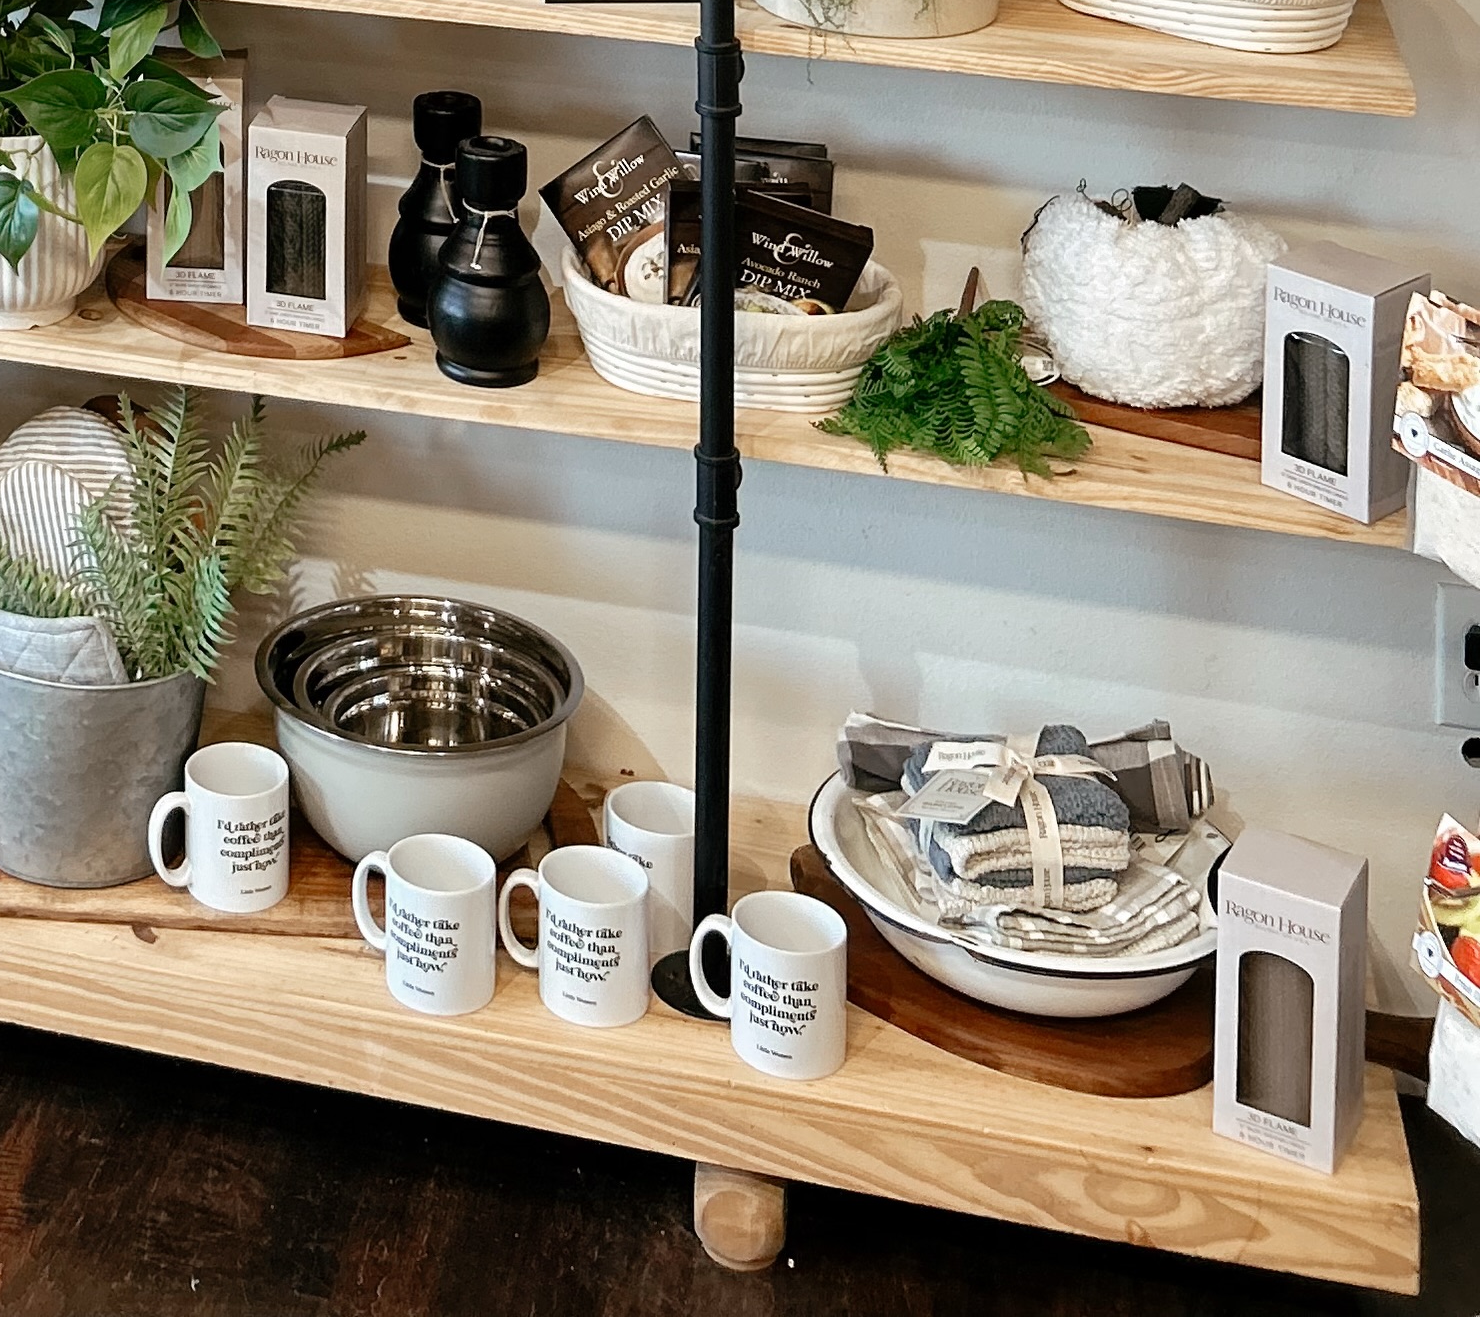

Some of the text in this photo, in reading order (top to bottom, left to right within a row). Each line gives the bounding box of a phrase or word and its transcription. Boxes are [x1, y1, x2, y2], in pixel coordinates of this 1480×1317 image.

[255, 145, 338, 167] Ragon House
[577, 164, 680, 242] Asiago Roasted Garlic
[606, 193, 666, 242] DIP MIX
[739, 269, 813, 301] DIP MIX
[740, 256, 823, 290] Avocado Ranch
[1272, 285, 1367, 328] Ragon House
[223, 833, 262, 845] coffee
[234, 821, 268, 833] rather
[399, 907, 461, 931] rather take
[558, 920, 623, 939] rather take
[1225, 898, 1331, 945] Ragon House
[424, 932, 459, 948] than
[546, 939, 622, 970] compliments
[549, 928, 621, 955] coffee than
[742, 978, 817, 1010] coffee than
[751, 969, 820, 993] rather take
[739, 991, 818, 1024] compliments
